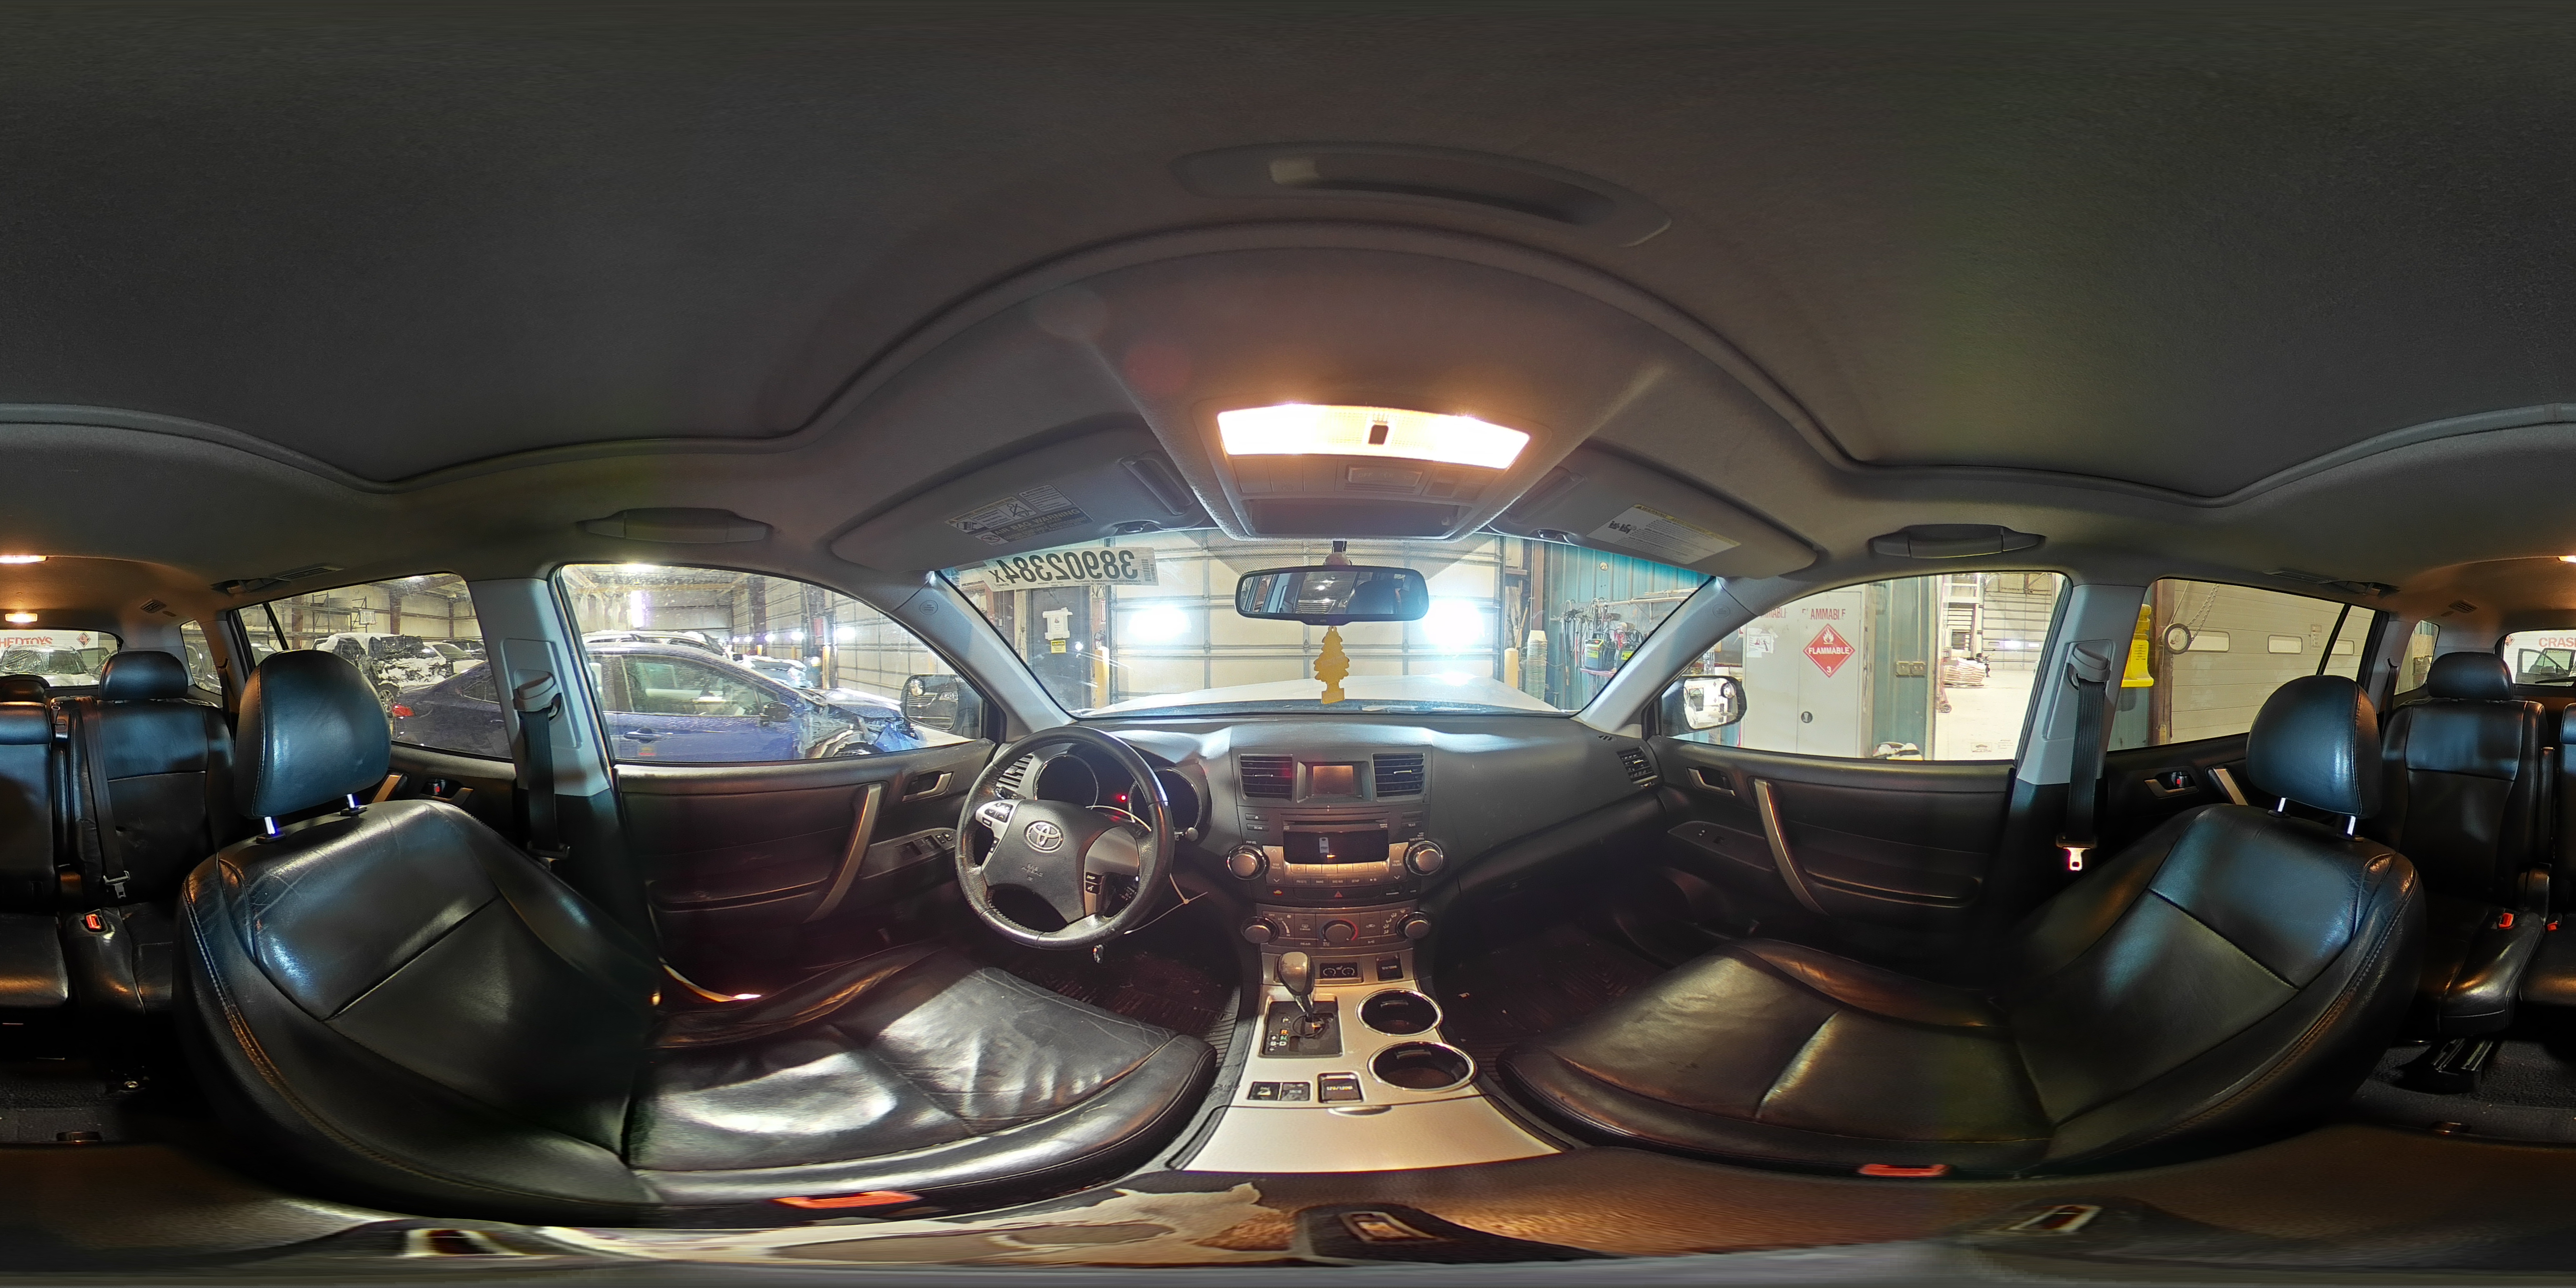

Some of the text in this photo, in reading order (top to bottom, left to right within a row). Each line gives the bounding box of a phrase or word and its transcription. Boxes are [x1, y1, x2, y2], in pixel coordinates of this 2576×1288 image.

[1010, 521, 1032, 530] BAG
[1032, 508, 1081, 524] WARNING
[2538, 637, 2576, 647] CRAS
